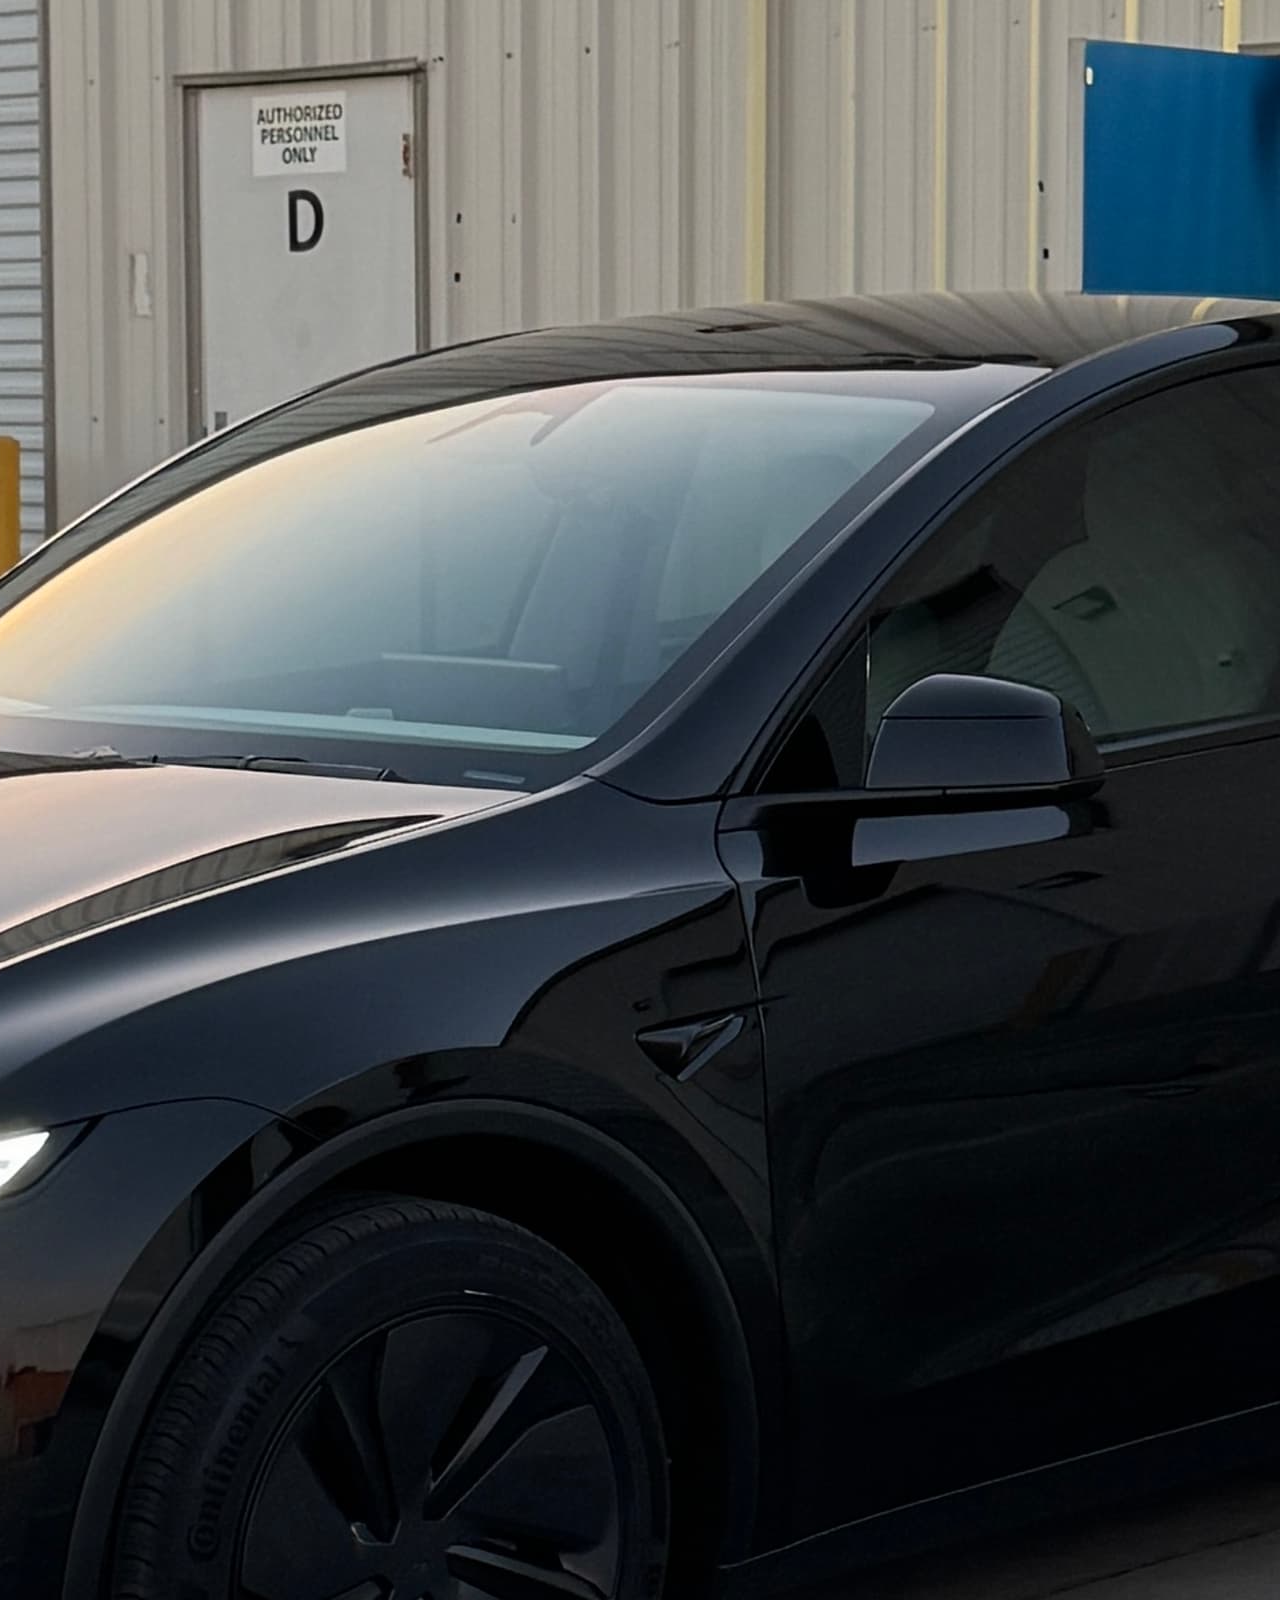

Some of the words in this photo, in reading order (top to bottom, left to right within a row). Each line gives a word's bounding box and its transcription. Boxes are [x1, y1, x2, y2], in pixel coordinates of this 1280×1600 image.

[257, 103, 343, 125] AUTHORIZED
[261, 125, 339, 144] PERSONNEL
[282, 147, 317, 164] ONLY
[288, 190, 324, 252] D
